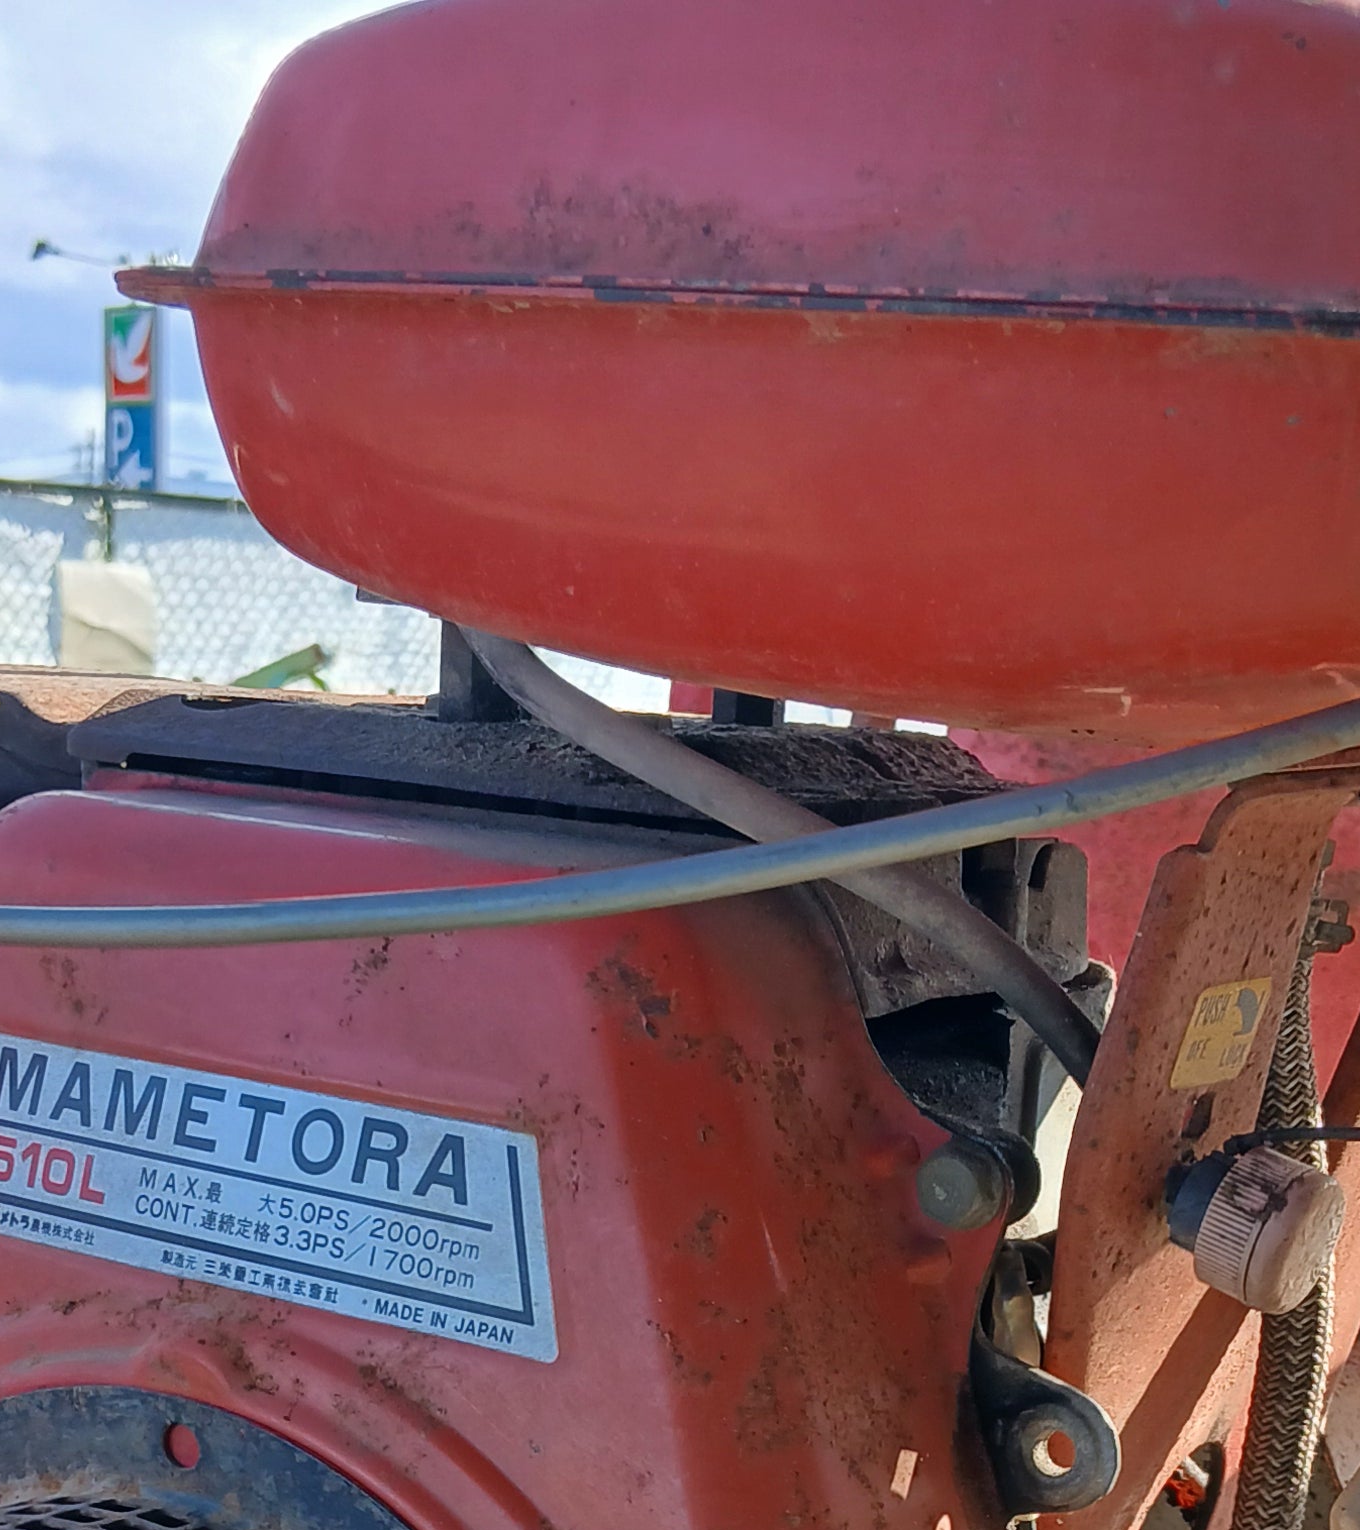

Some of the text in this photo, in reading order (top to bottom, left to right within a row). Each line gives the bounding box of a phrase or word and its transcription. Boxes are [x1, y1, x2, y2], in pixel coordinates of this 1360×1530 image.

[110, 408, 134, 468] P
[374, 1298, 515, 1346] MADE IN JAPAN
